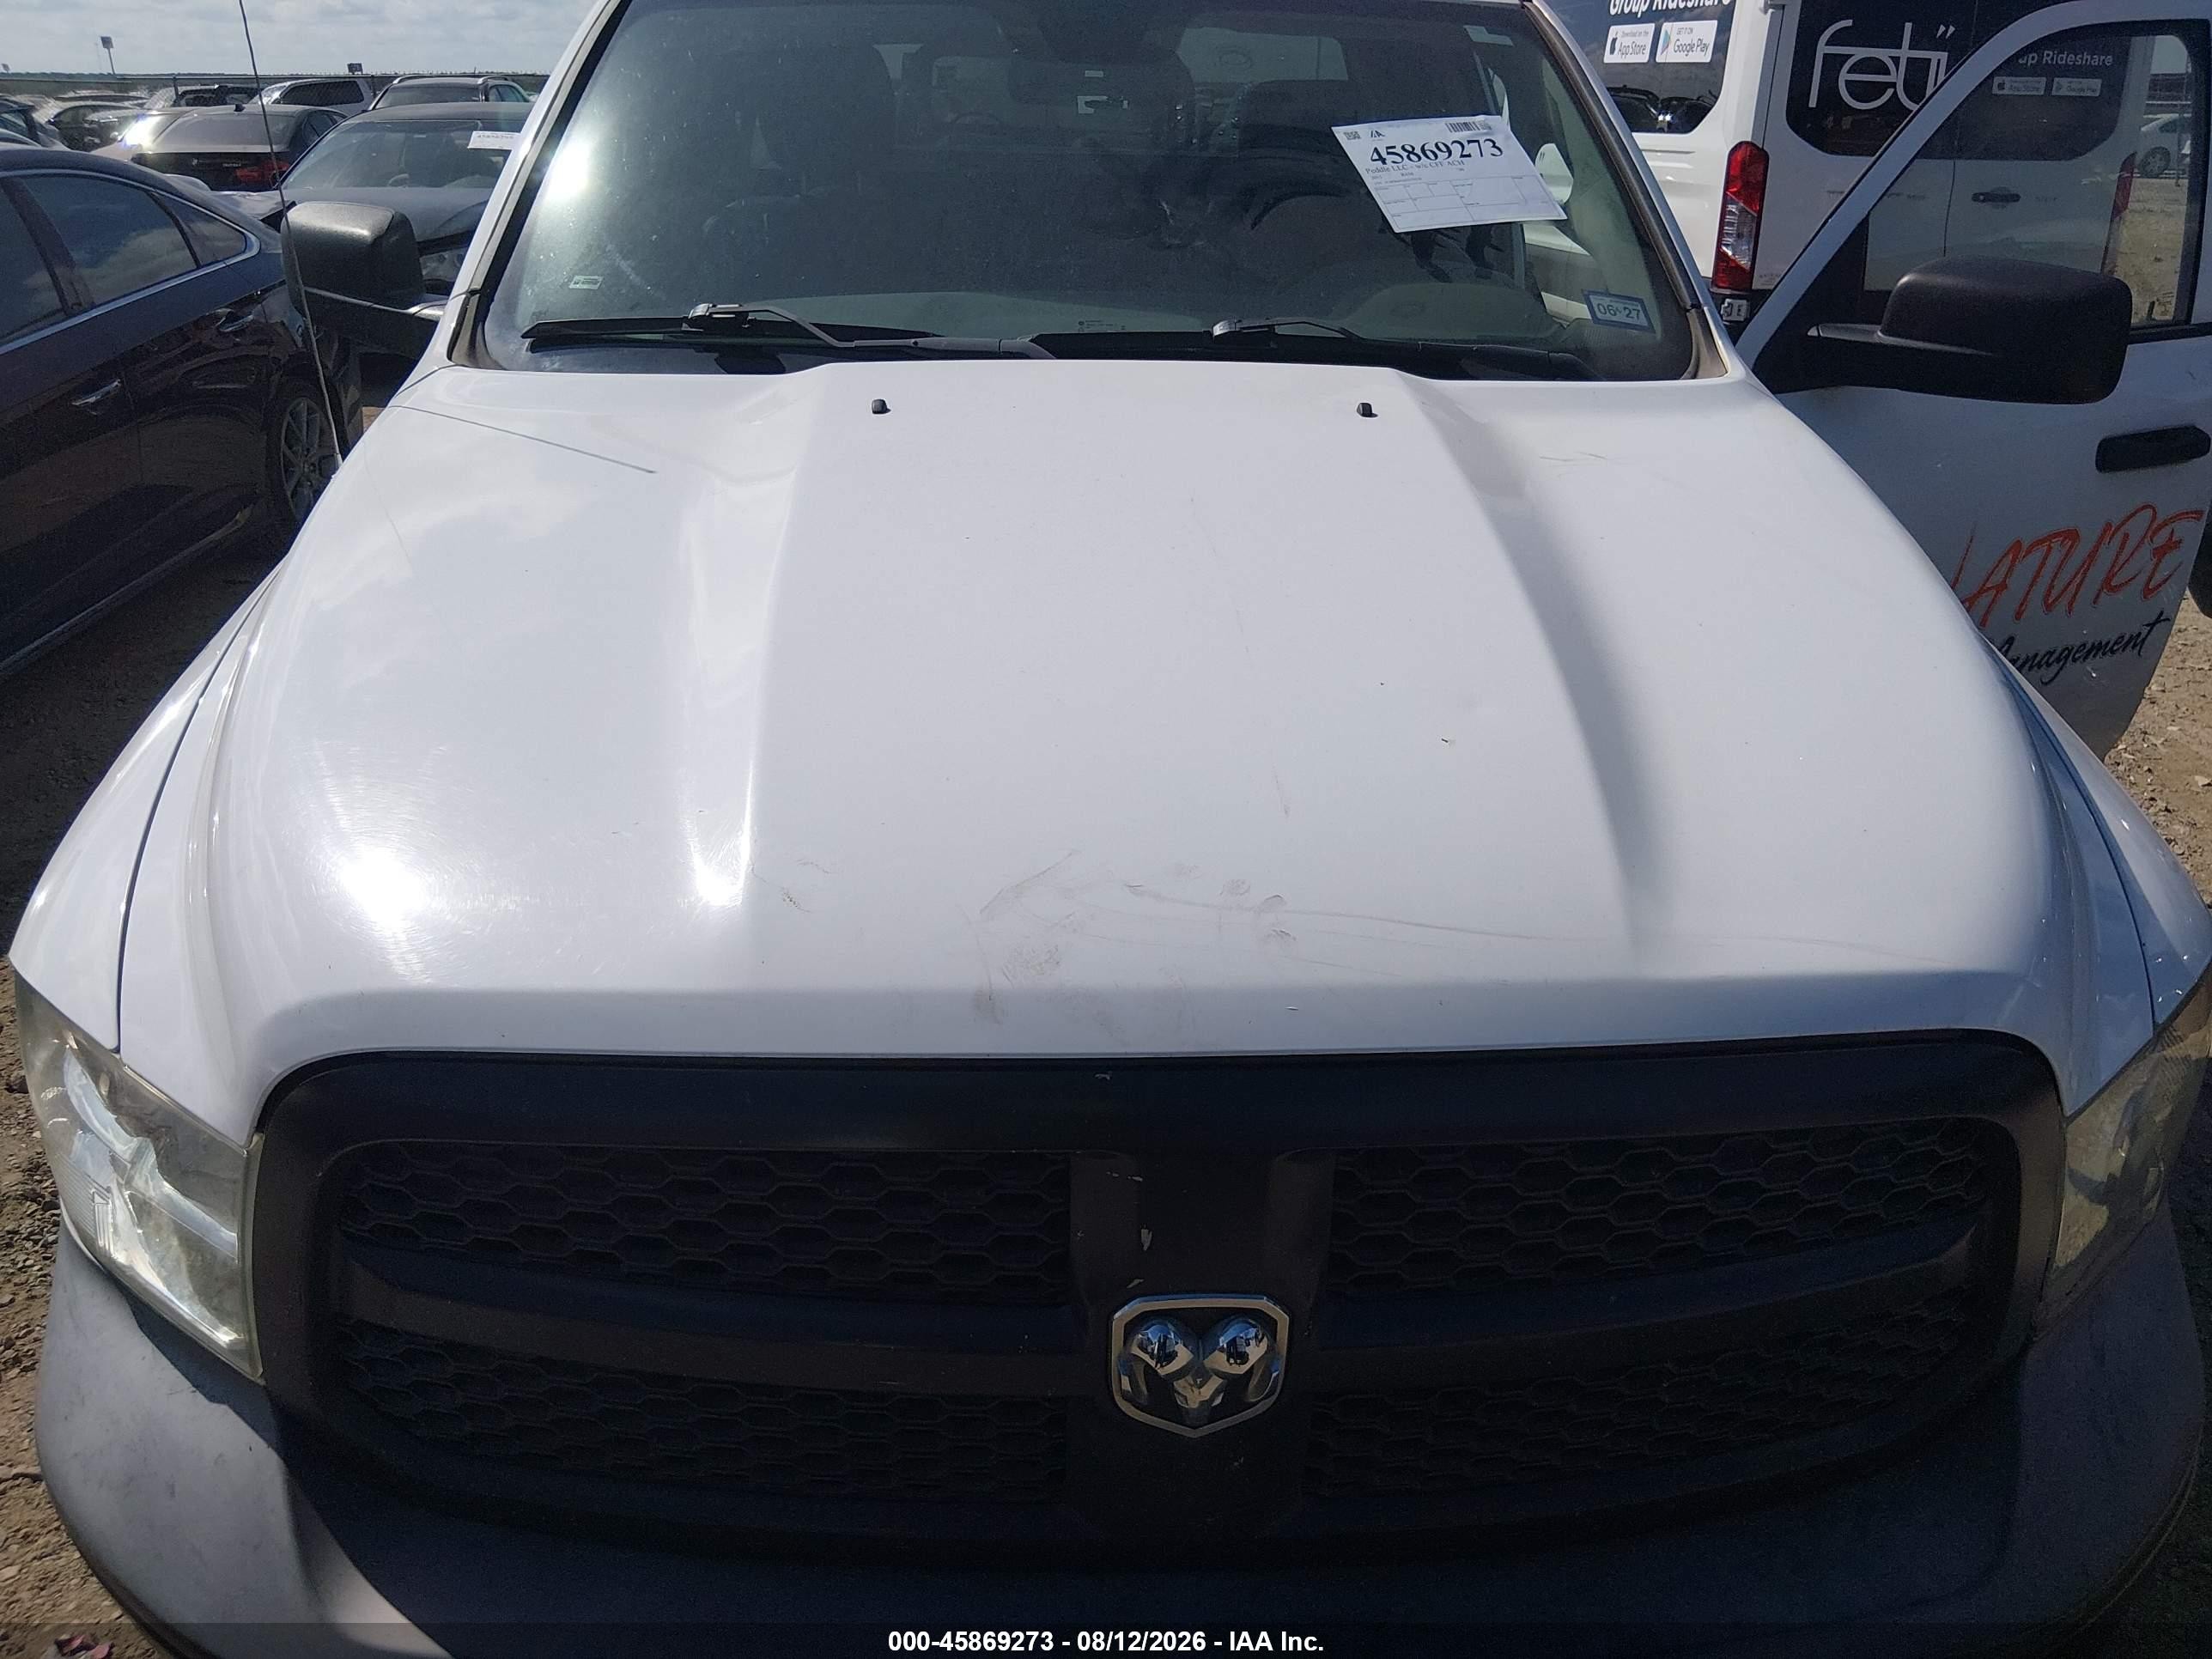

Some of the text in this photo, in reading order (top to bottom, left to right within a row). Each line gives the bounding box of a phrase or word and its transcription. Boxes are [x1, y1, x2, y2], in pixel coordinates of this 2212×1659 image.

[1609, 0, 1650, 18] Group
[1618, 41, 1647, 59] App Store
[1674, 38, 1711, 57] Google Play
[2043, 51, 2113, 66] Rideshare
[1370, 138, 1504, 166] 45869273
[1597, 303, 1618, 317] 06
[1622, 307, 1641, 320] 27
